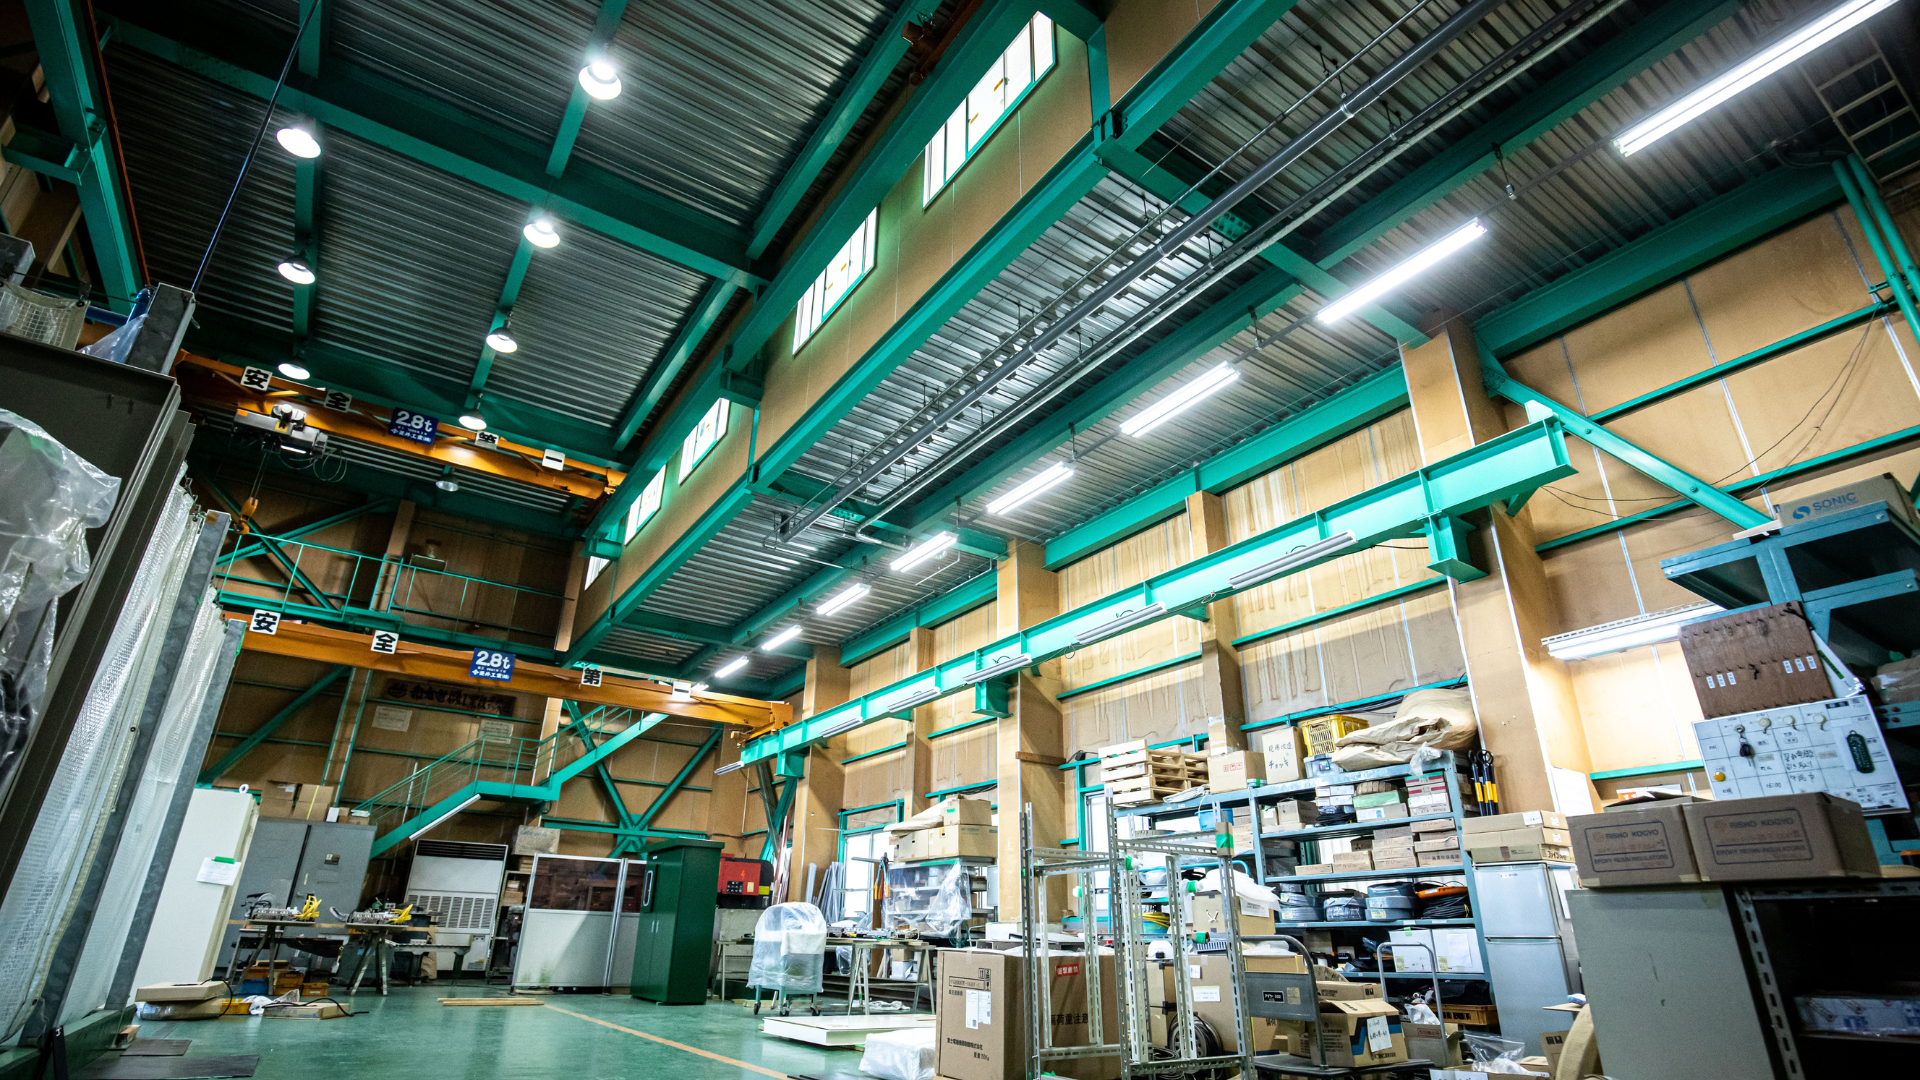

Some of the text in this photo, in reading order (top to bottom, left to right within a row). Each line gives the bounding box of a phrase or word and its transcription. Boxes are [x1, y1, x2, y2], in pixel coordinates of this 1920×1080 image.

[243, 369, 269, 389] 安
[326, 391, 350, 412] 全
[395, 410, 433, 432] 2.8t
[1812, 492, 1857, 511] SONIC
[252, 612, 278, 633] 安
[373, 633, 397, 653] 全
[582, 667, 601, 686] 第
[475, 650, 511, 670] 2.8t
[1729, 817, 1794, 829] RISHO KOGYO
[1605, 829, 1659, 839] RISHO KOGYO
